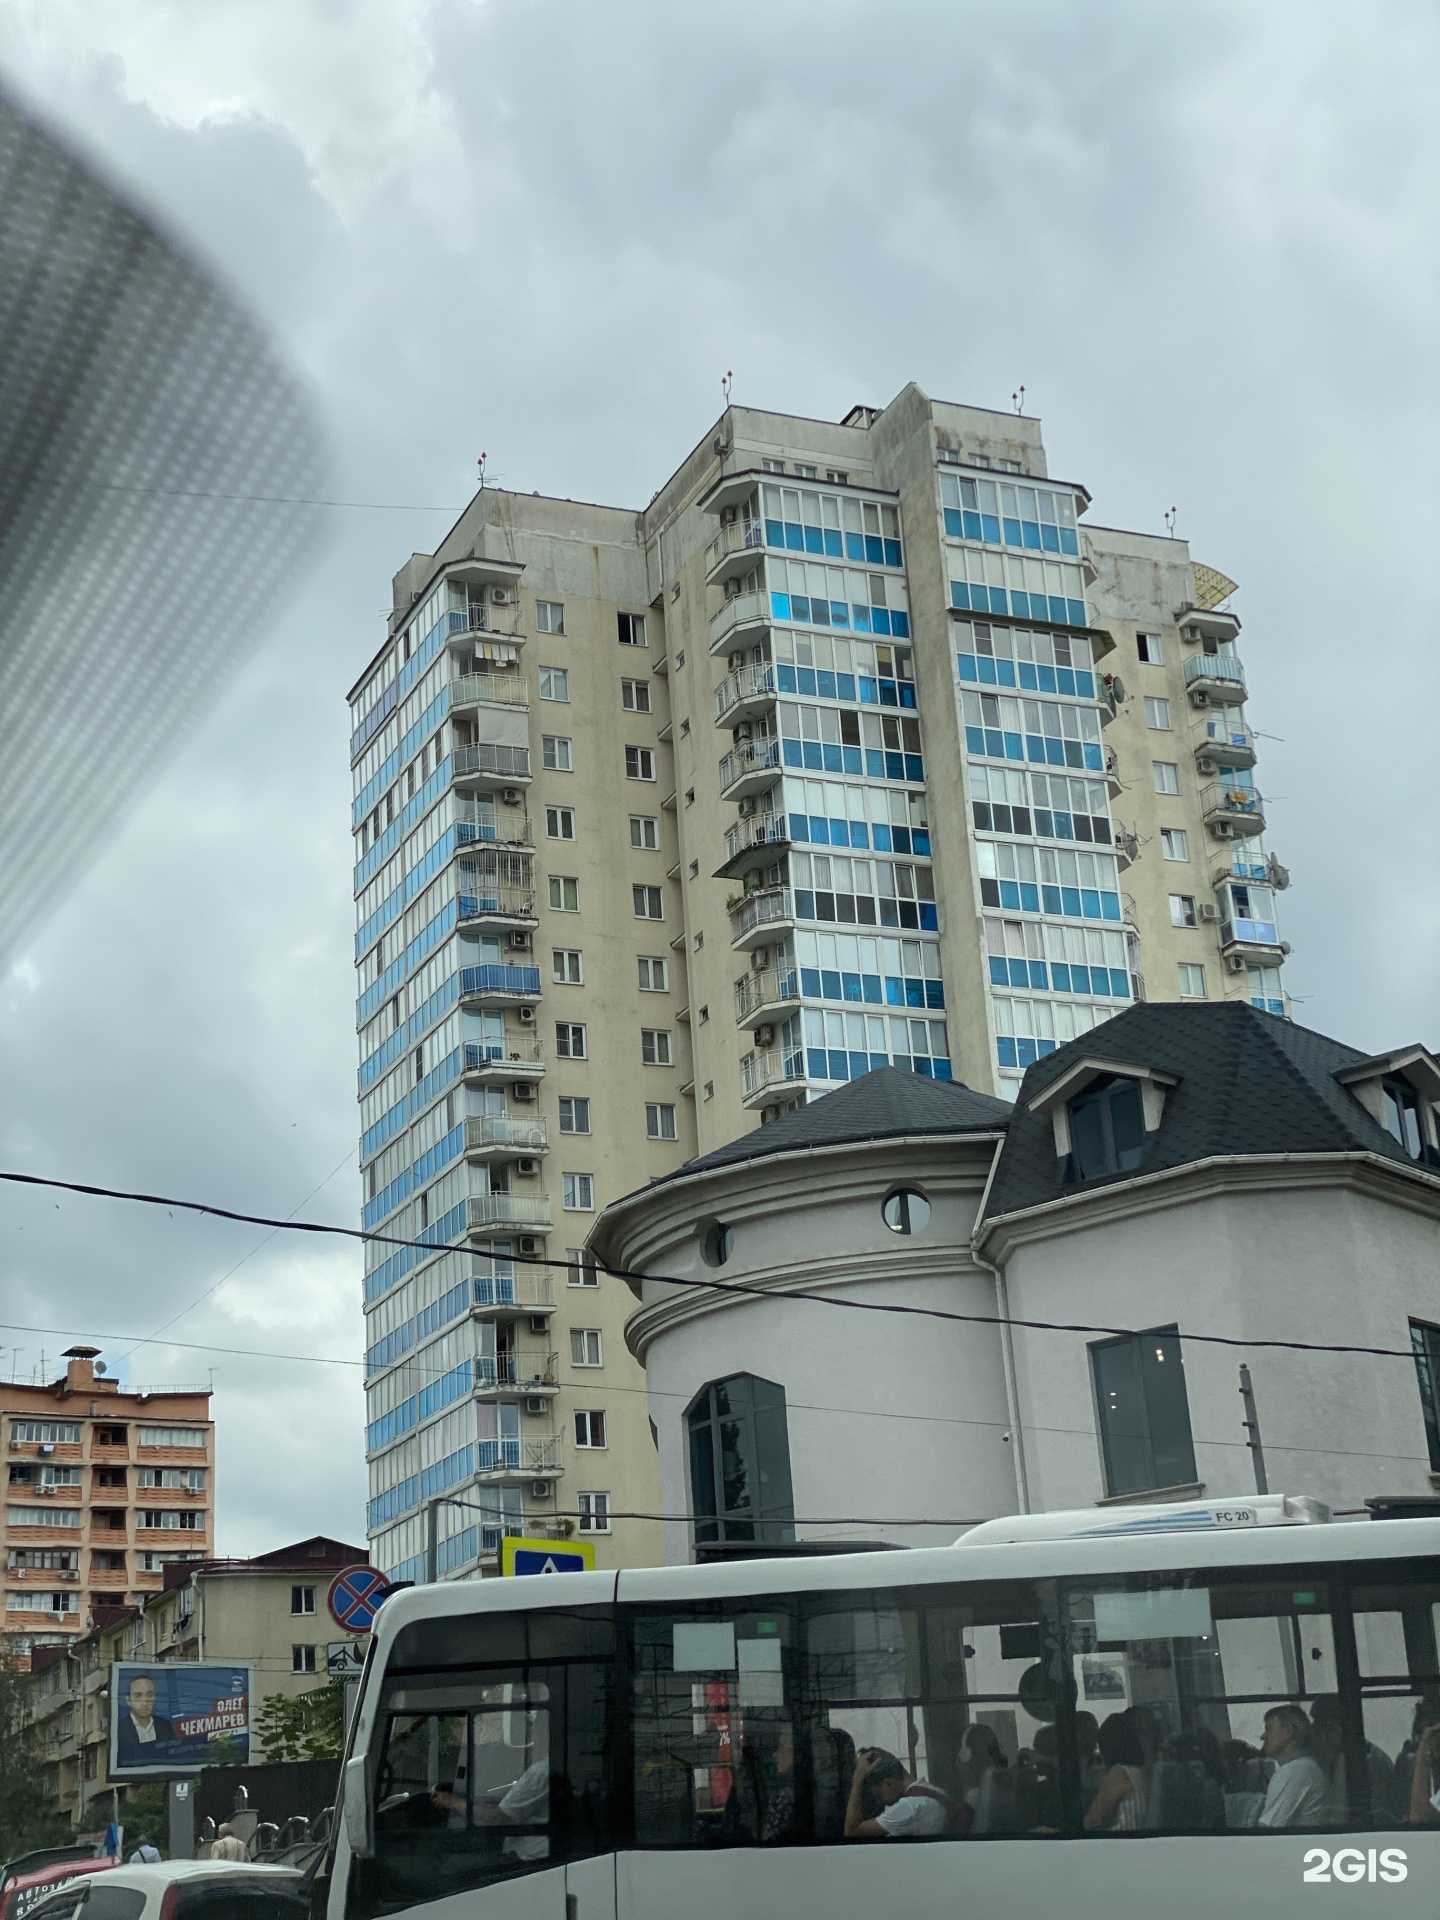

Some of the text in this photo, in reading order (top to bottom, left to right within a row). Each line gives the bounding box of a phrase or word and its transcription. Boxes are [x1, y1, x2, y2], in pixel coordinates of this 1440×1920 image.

[1215, 1511, 1249, 1521] FC 20
[217, 1697, 244, 1712] ОЛЕГ
[180, 1713, 245, 1735] ЧЕКМАРЕВ
